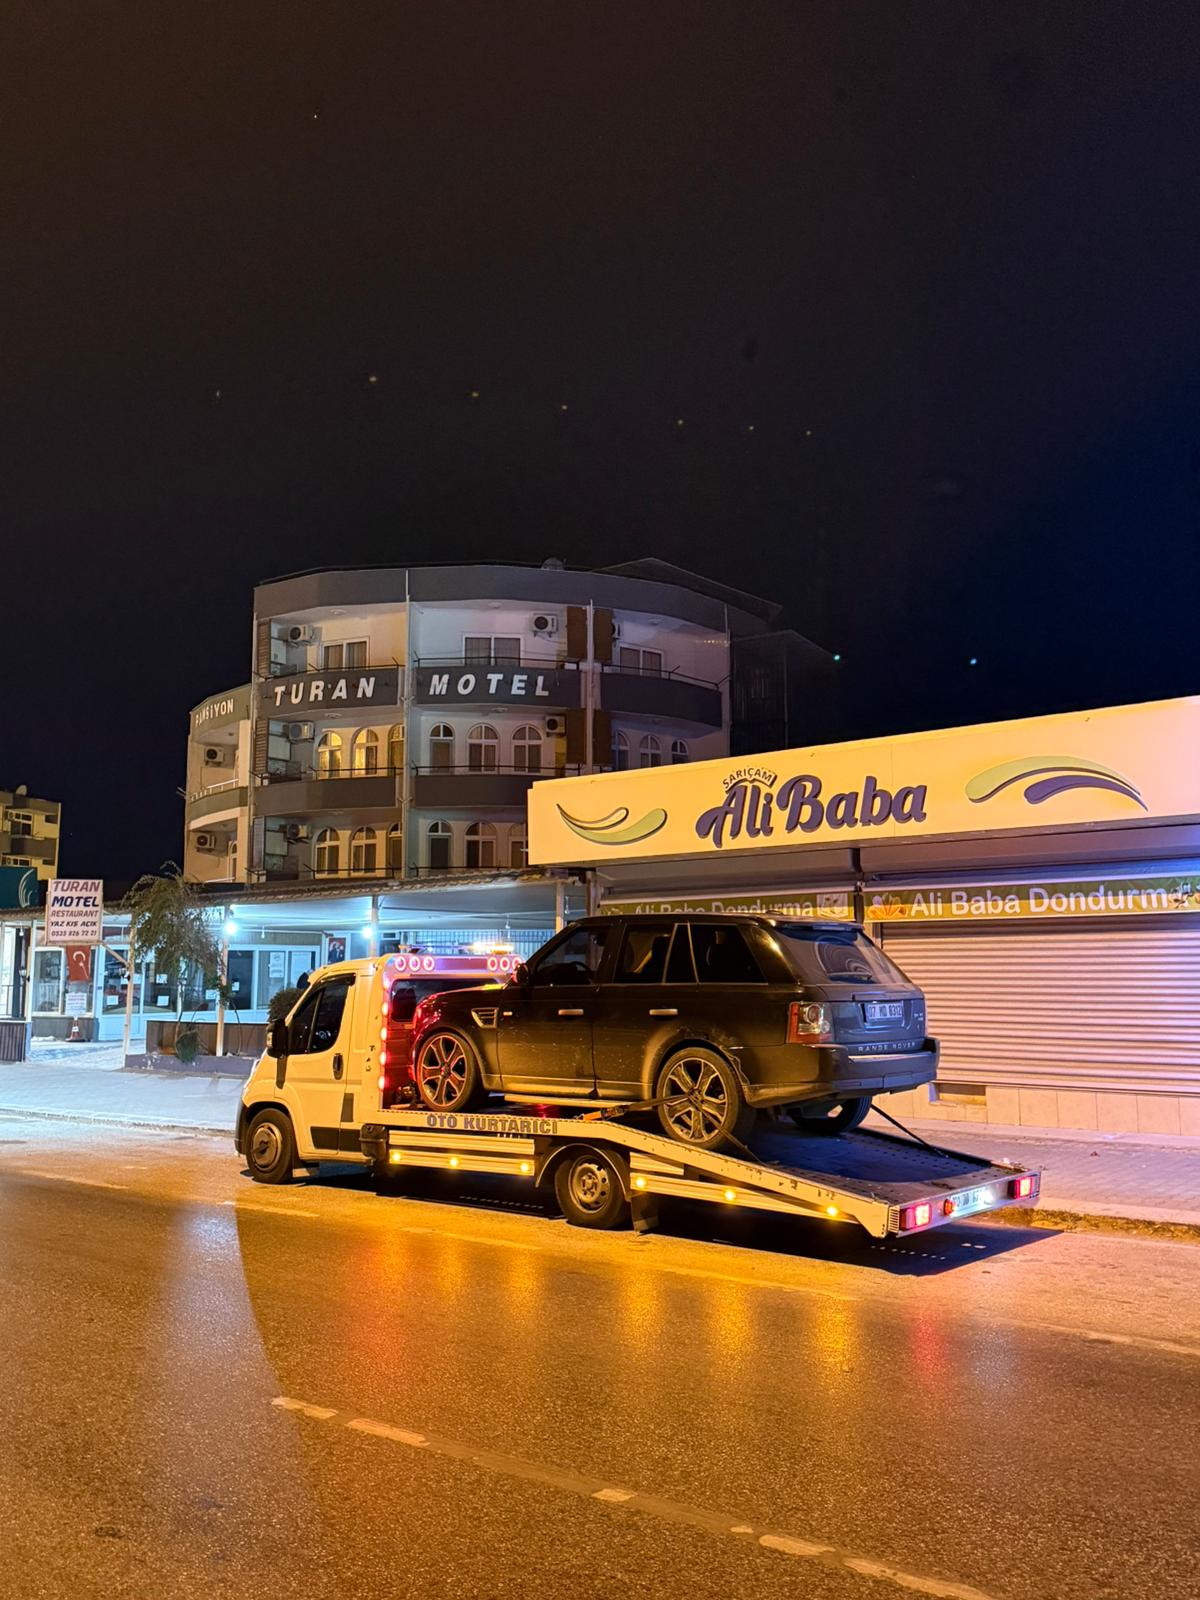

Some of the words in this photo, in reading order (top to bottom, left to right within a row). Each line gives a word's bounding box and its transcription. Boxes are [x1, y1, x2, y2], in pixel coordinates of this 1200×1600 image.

[274, 677, 376, 706] TURAN
[429, 674, 550, 696] MOTEL
[721, 767, 775, 789] SARIÇAM
[695, 785, 775, 848] Ali
[776, 774, 928, 833] Baba
[53, 881, 101, 892] TURAN
[51, 896, 99, 907] MOTEL
[911, 892, 943, 917] Ali
[951, 890, 1021, 916] Baba
[427, 1114, 458, 1128] OTO
[463, 1117, 558, 1134] KURTARICI
